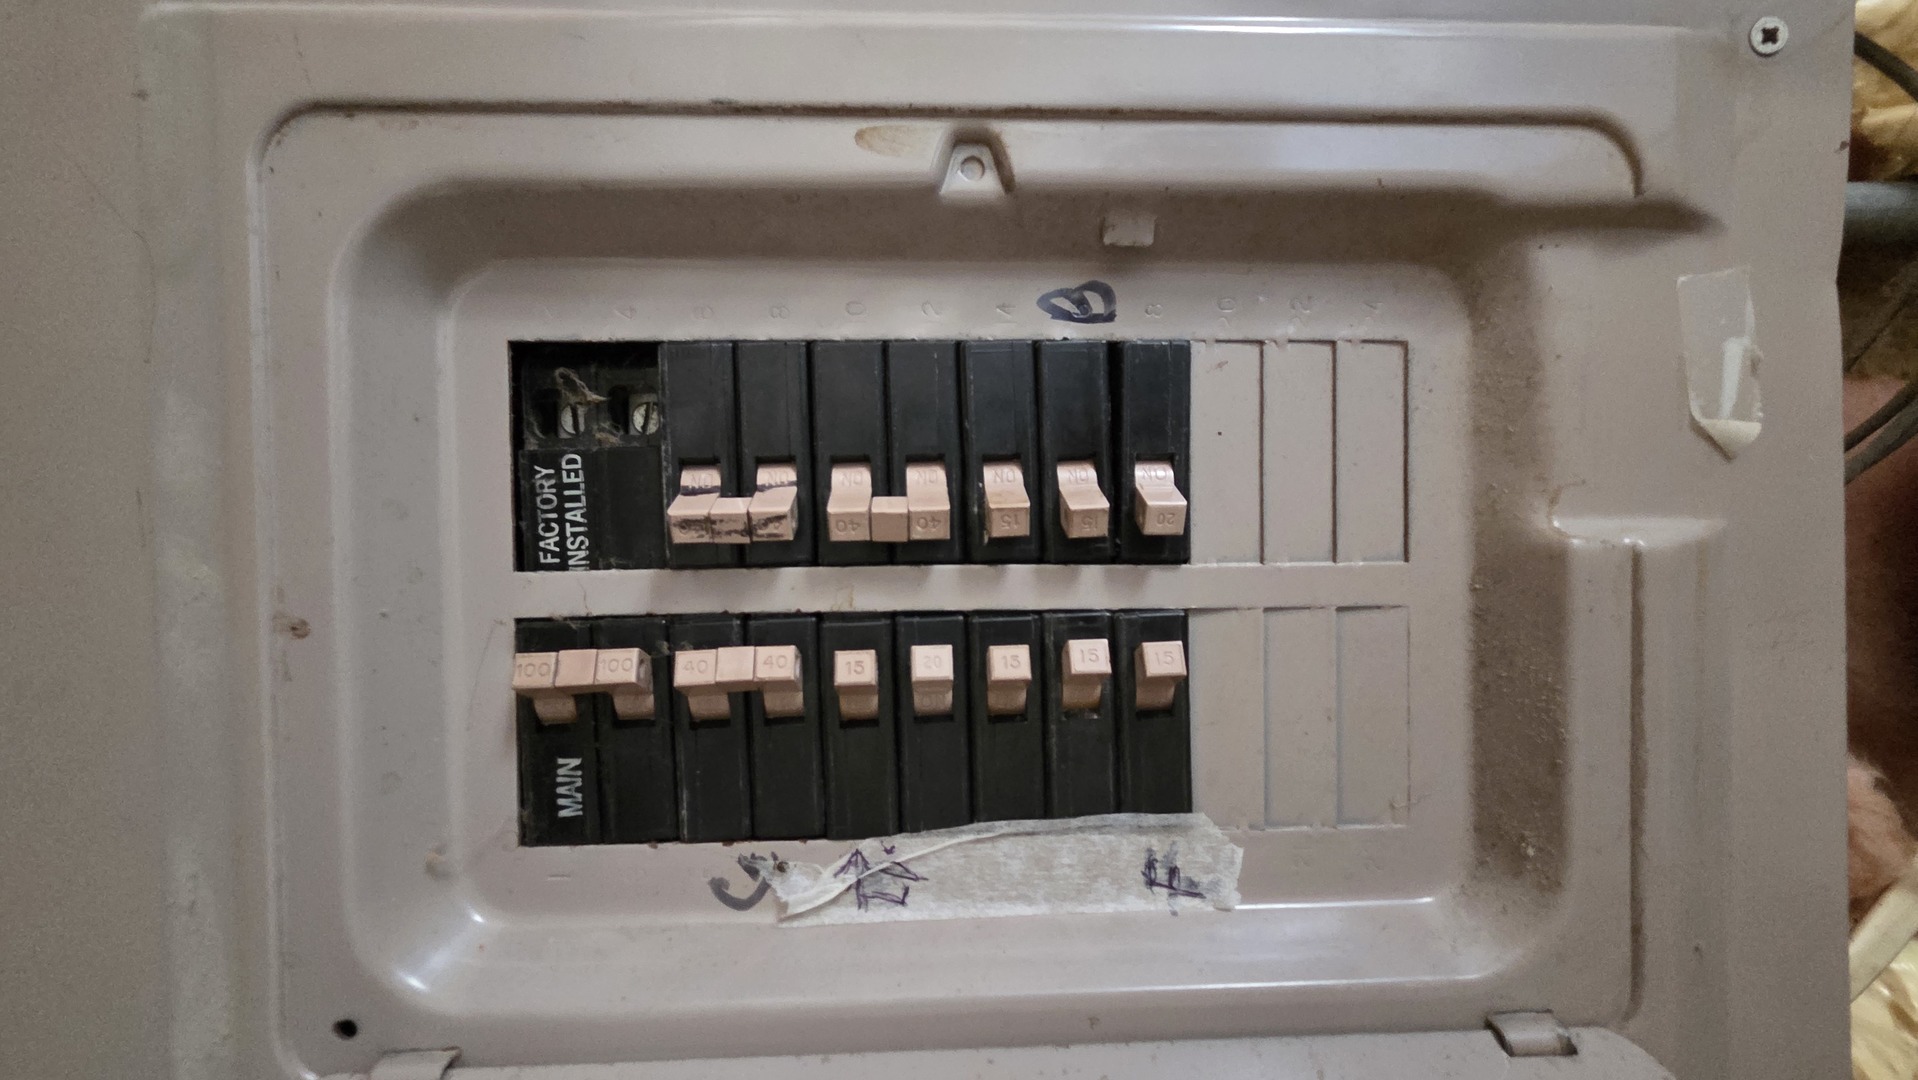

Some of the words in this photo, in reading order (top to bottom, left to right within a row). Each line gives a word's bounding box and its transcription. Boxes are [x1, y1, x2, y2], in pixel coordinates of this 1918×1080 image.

[534, 465, 561, 564] FACTORY
[561, 453, 590, 571] INSTALLED
[1156, 511, 1176, 527] 20
[762, 653, 788, 669] 40
[1001, 654, 1021, 670] 15
[1080, 647, 1100, 664] 15
[1153, 650, 1175, 666] 15
[517, 661, 551, 679] 100
[599, 656, 634, 673] 100
[682, 658, 709, 675] 40
[845, 660, 866, 676] 15
[555, 757, 583, 818] MAIN
